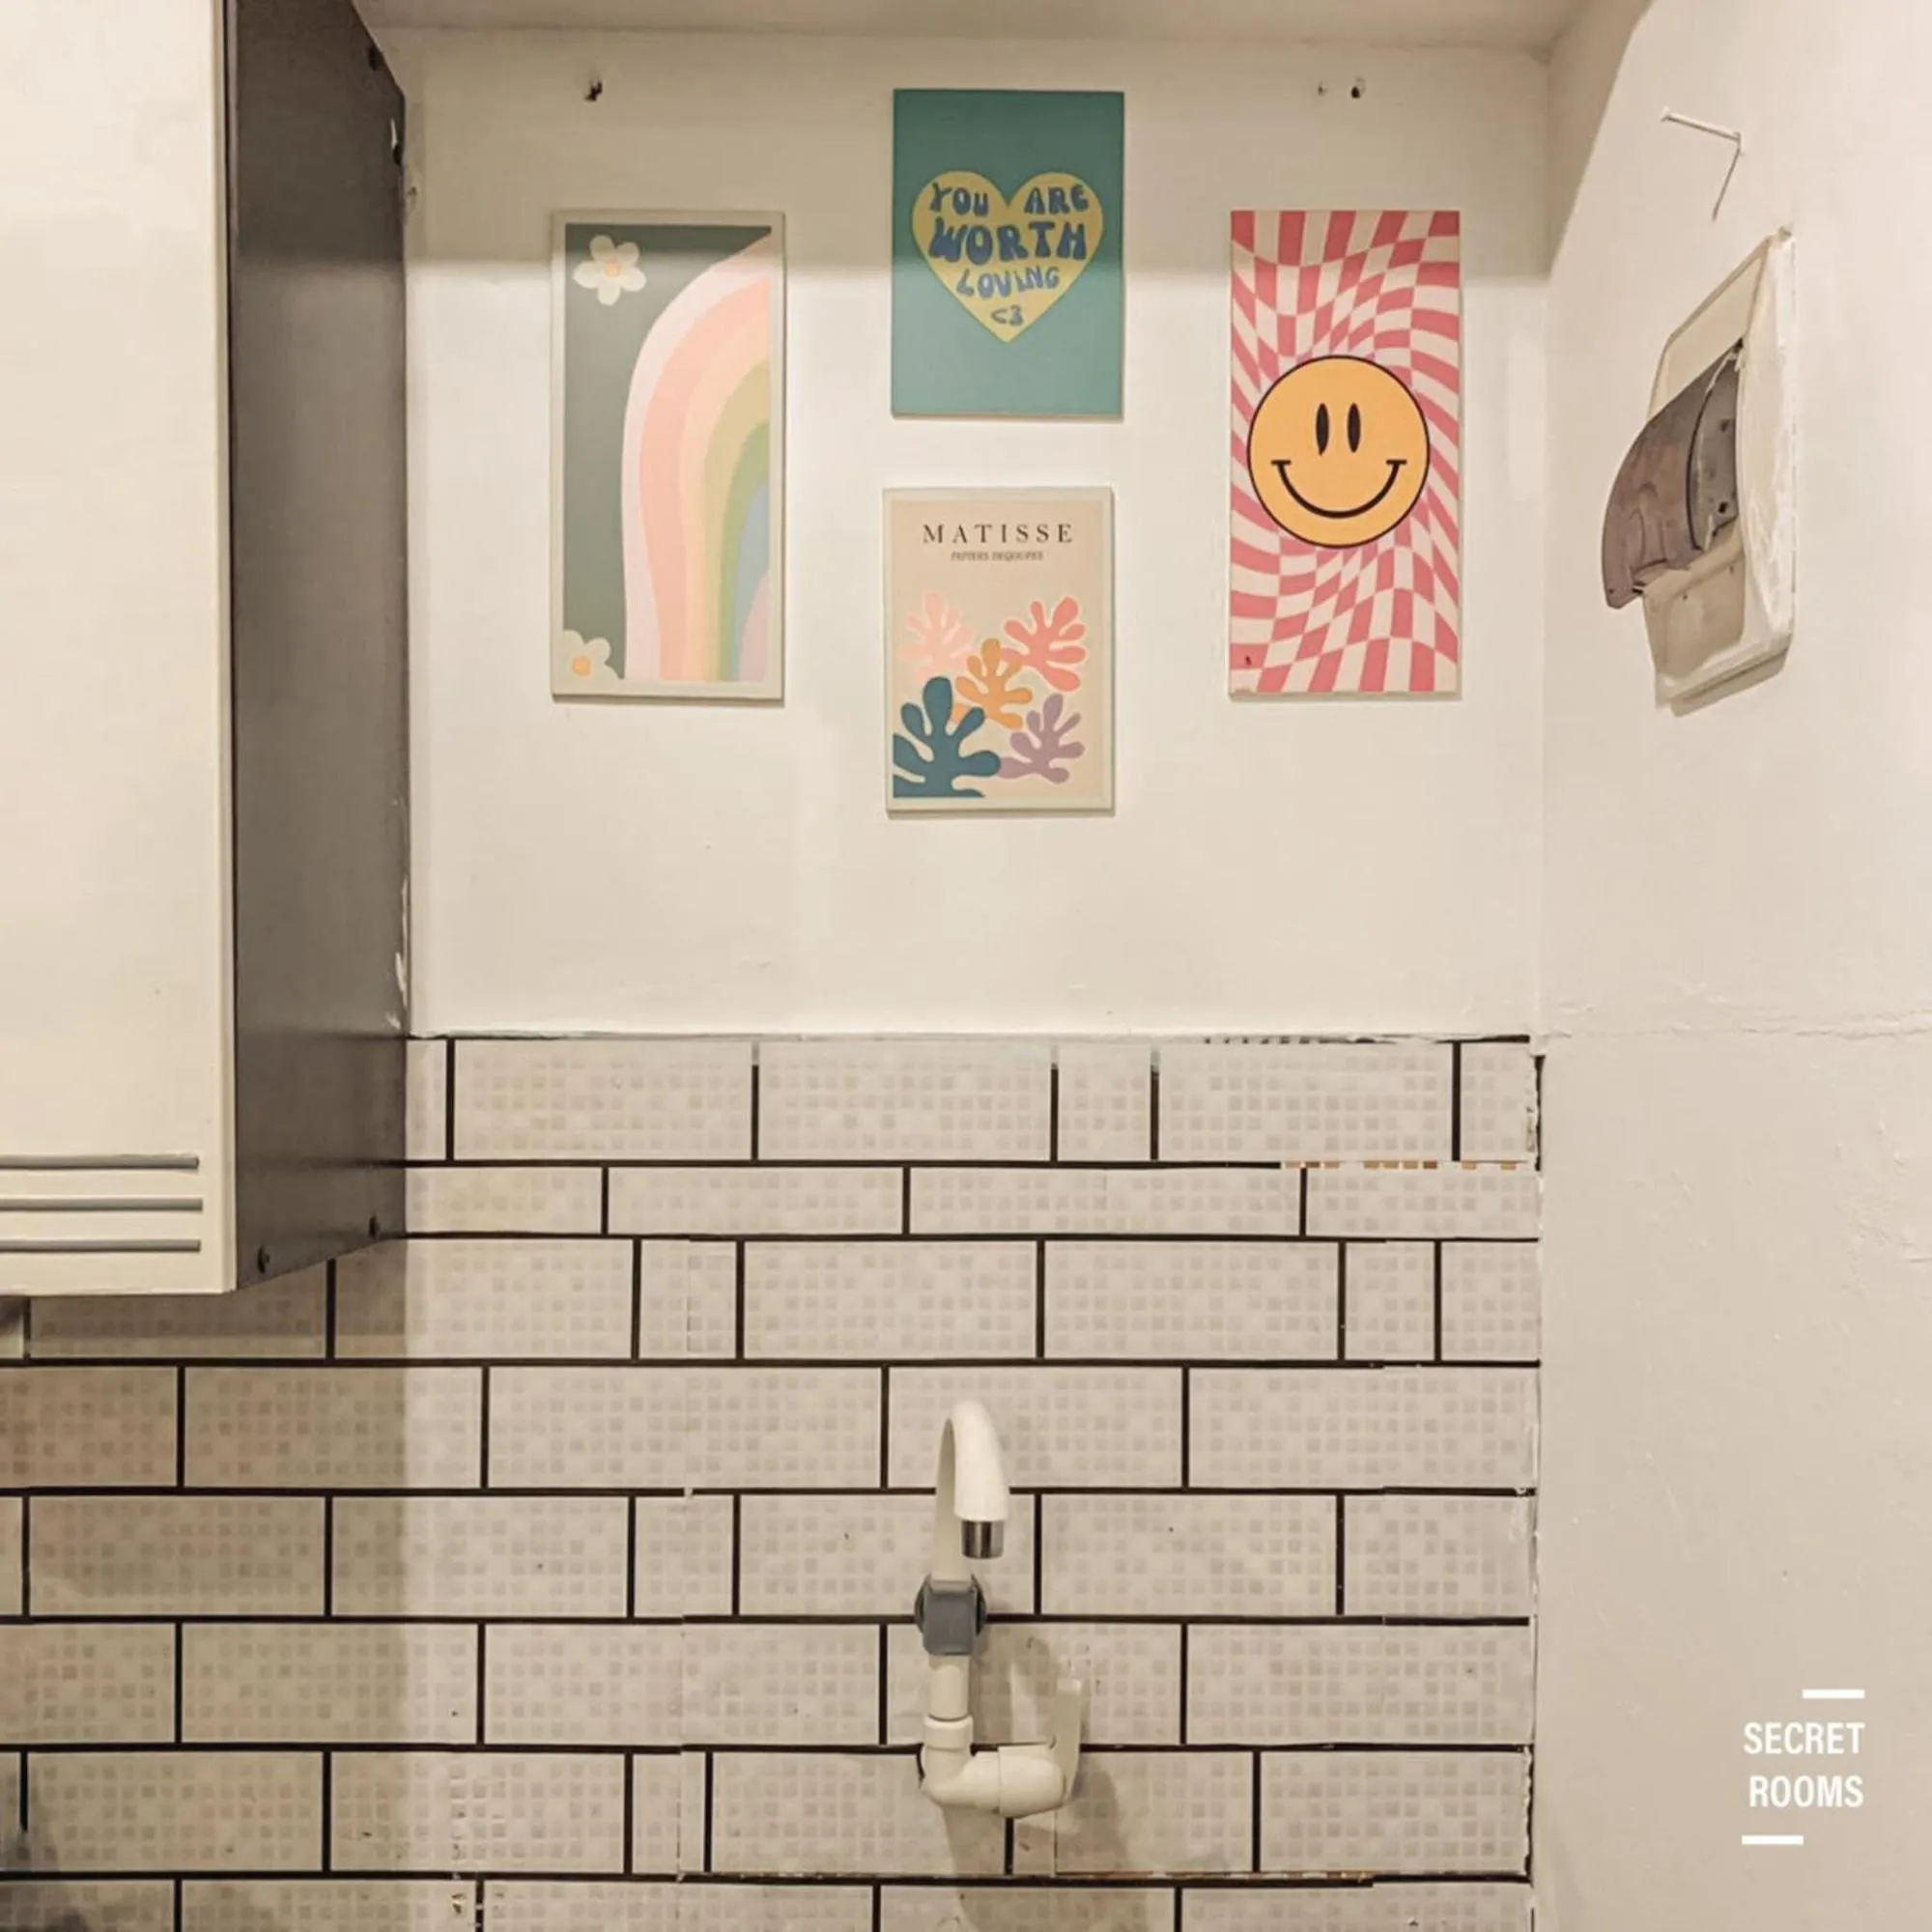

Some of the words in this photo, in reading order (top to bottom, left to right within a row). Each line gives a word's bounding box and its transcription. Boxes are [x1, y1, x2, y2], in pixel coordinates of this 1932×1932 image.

[929, 182, 989, 216] YOU
[1024, 184, 1089, 214] ARE
[929, 217, 1087, 265] WORTH
[956, 266, 1060, 298] LOVING
[923, 524, 1072, 544] MATISSE
